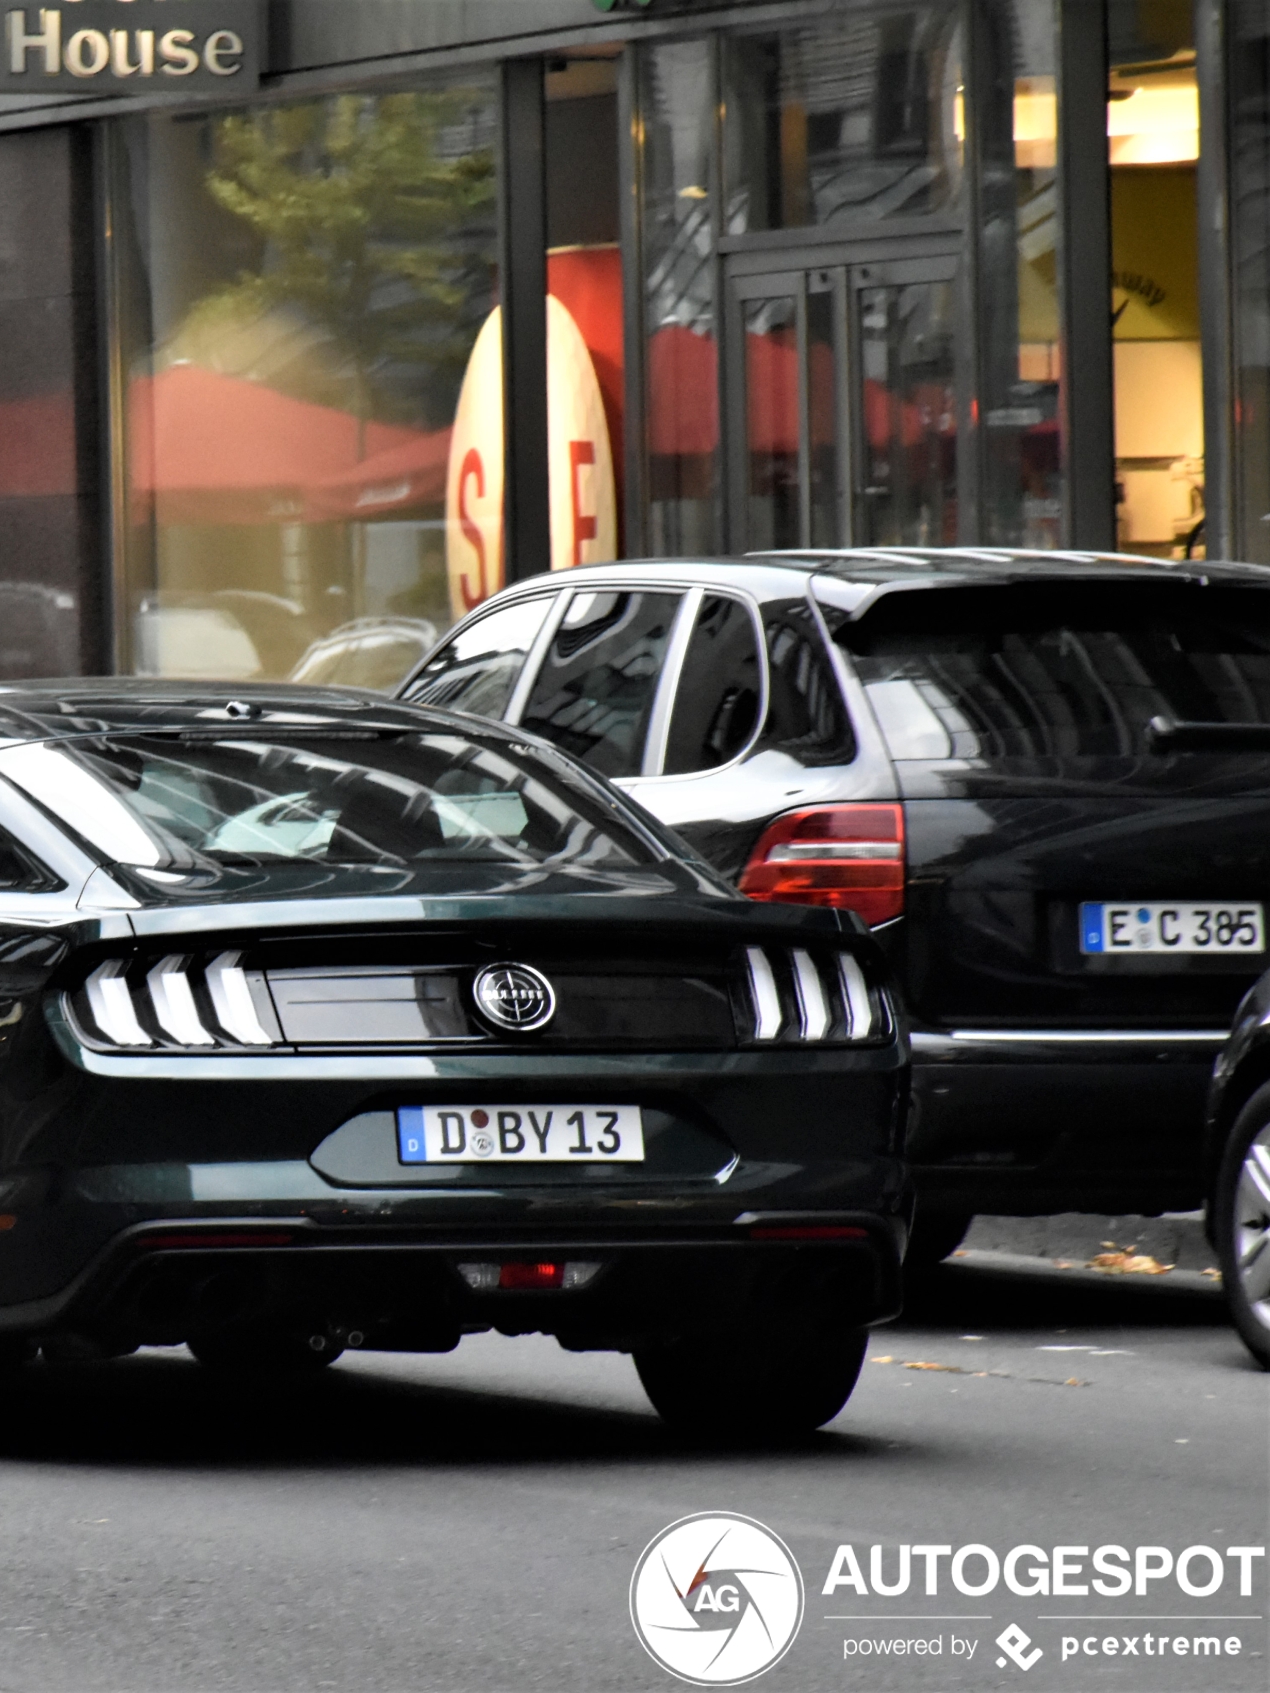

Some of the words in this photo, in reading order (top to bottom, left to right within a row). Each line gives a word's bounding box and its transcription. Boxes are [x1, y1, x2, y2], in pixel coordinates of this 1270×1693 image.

[6, 8, 244, 78] House
[1110, 910, 1131, 947] E
[1159, 910, 1180, 947] C
[1192, 910, 1257, 947] 385
[437, 1111, 467, 1155] D
[497, 1111, 554, 1154] BY
[566, 1111, 621, 1154] 13
